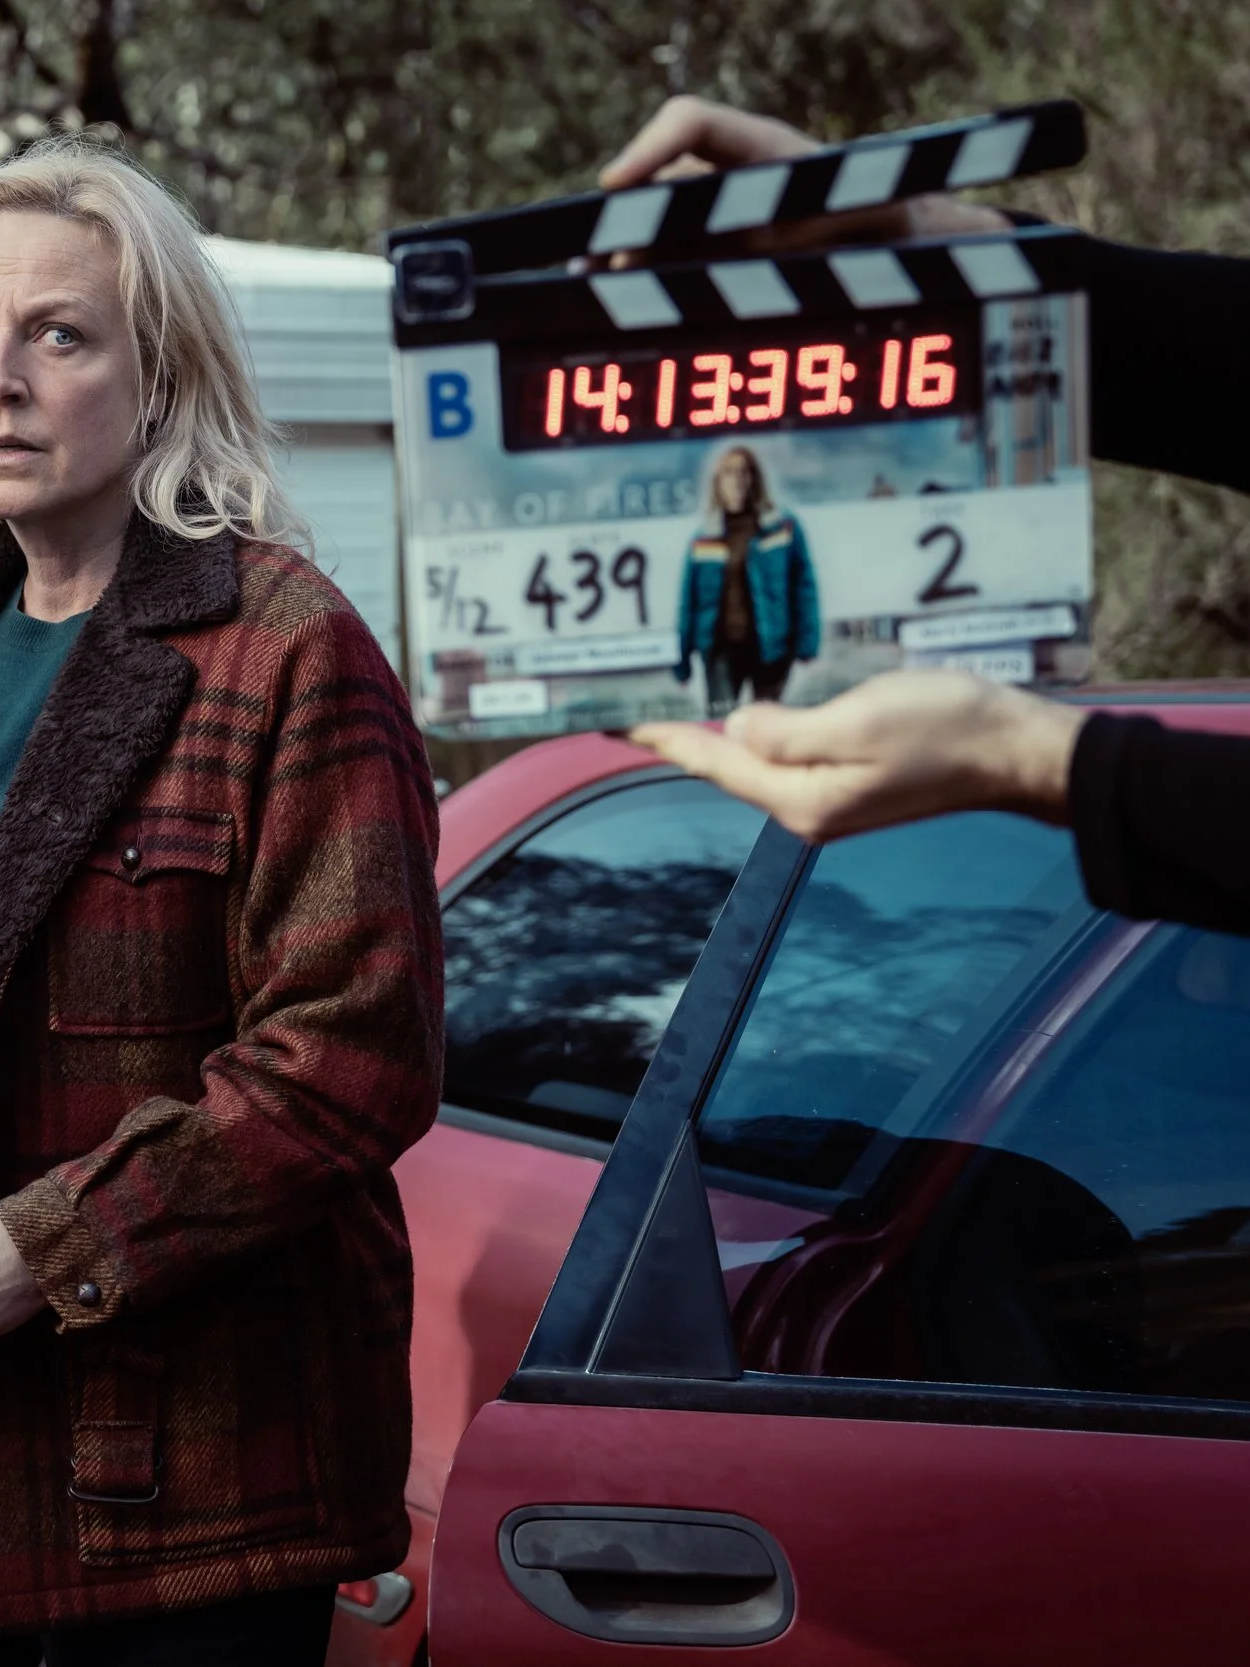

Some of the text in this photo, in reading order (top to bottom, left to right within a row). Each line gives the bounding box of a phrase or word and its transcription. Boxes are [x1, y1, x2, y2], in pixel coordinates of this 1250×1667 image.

[426, 370, 475, 439] B
[513, 488, 567, 526] OF
[523, 545, 647, 633] 439
[916, 521, 982, 606] 2
